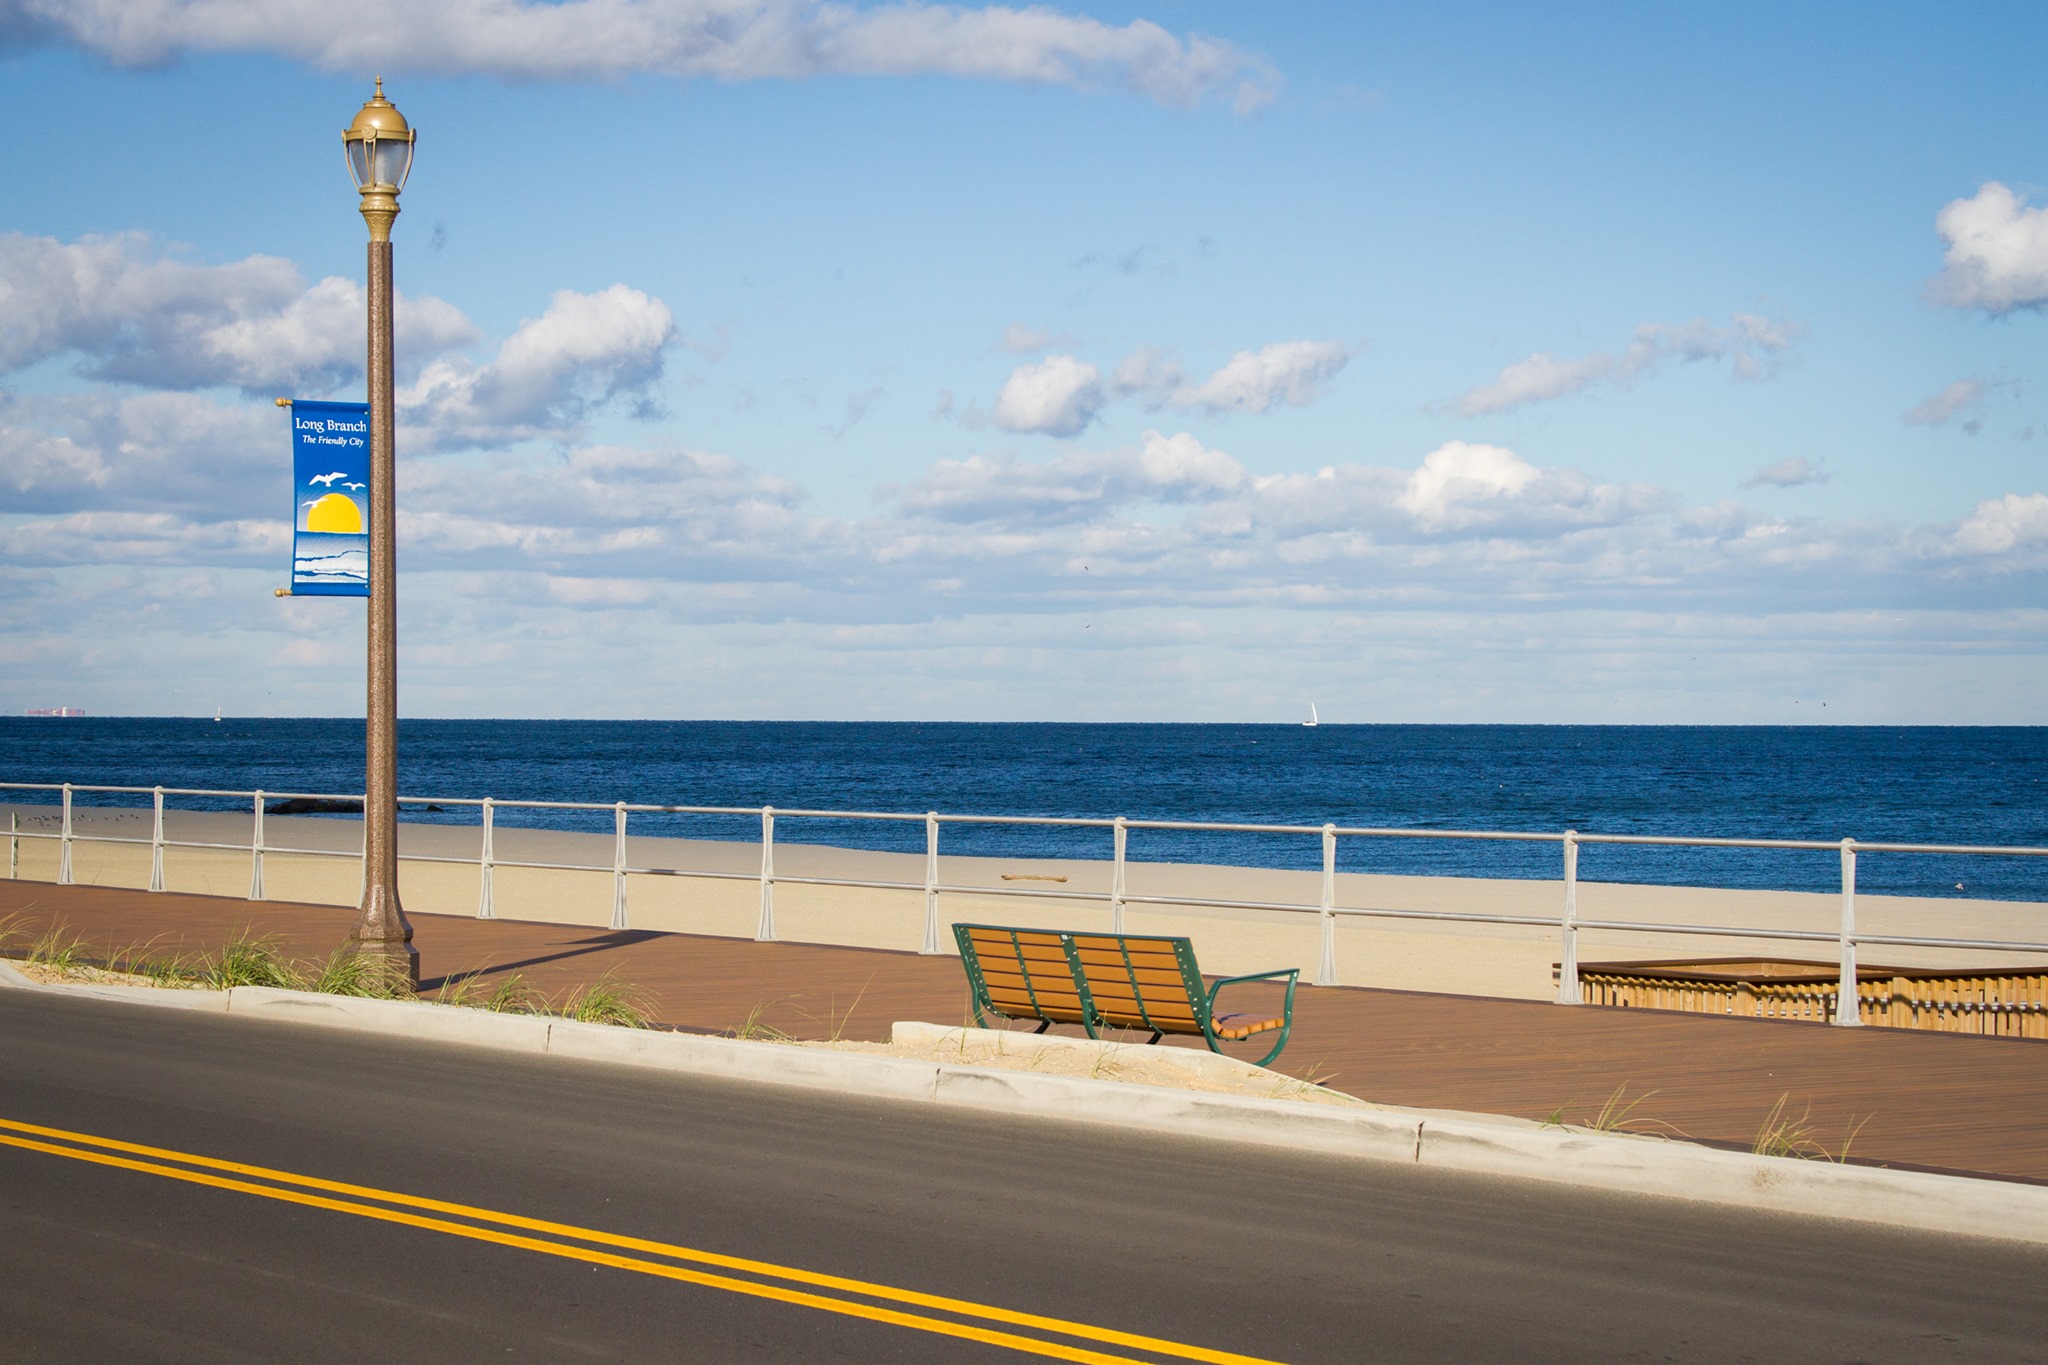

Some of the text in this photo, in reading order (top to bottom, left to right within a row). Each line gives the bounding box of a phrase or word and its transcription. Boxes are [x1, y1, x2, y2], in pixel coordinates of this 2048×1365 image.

[295, 417, 366, 433] Long Branch
[302, 434, 364, 448] The Friendly City
